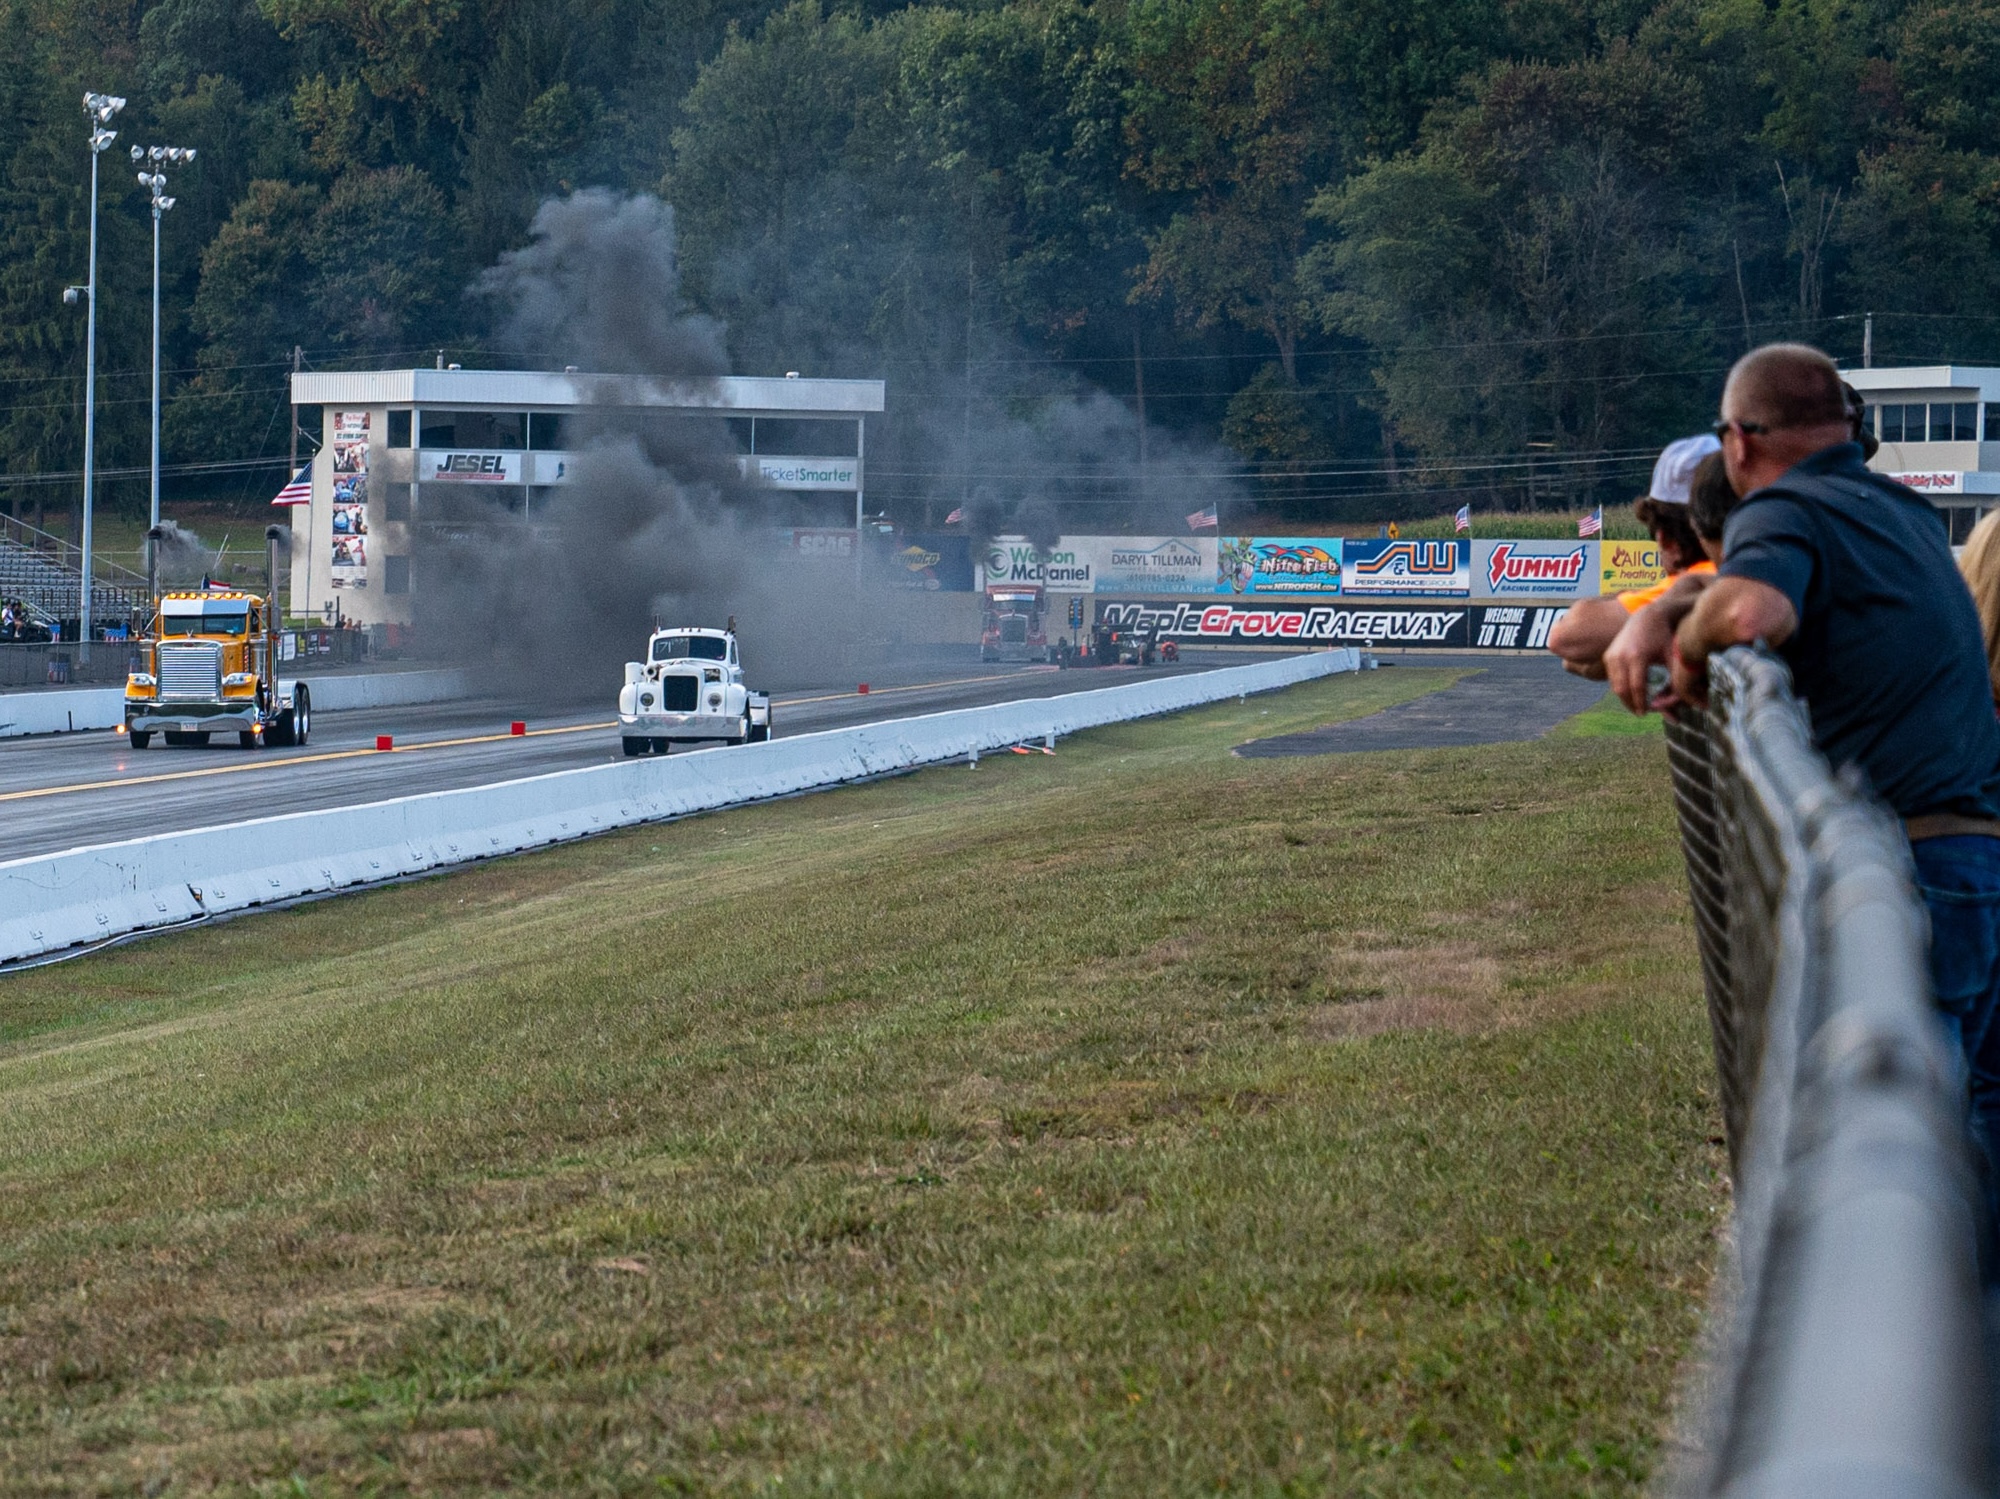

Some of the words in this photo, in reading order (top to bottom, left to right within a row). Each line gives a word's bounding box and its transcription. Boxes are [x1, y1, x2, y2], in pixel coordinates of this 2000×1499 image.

[437, 454, 506, 473] JESEL
[761, 467, 852, 482] TicketSmarter
[799, 535, 851, 557] SCAG
[1112, 554, 1149, 566] DARYL
[1151, 555, 1202, 566] TILLMAN
[1011, 565, 1090, 581] McDaniel
[1620, 570, 1657, 581] heating
[1484, 608, 1526, 624] WELCOME
[1477, 625, 1496, 646] TO
[1495, 625, 1520, 647] THE
